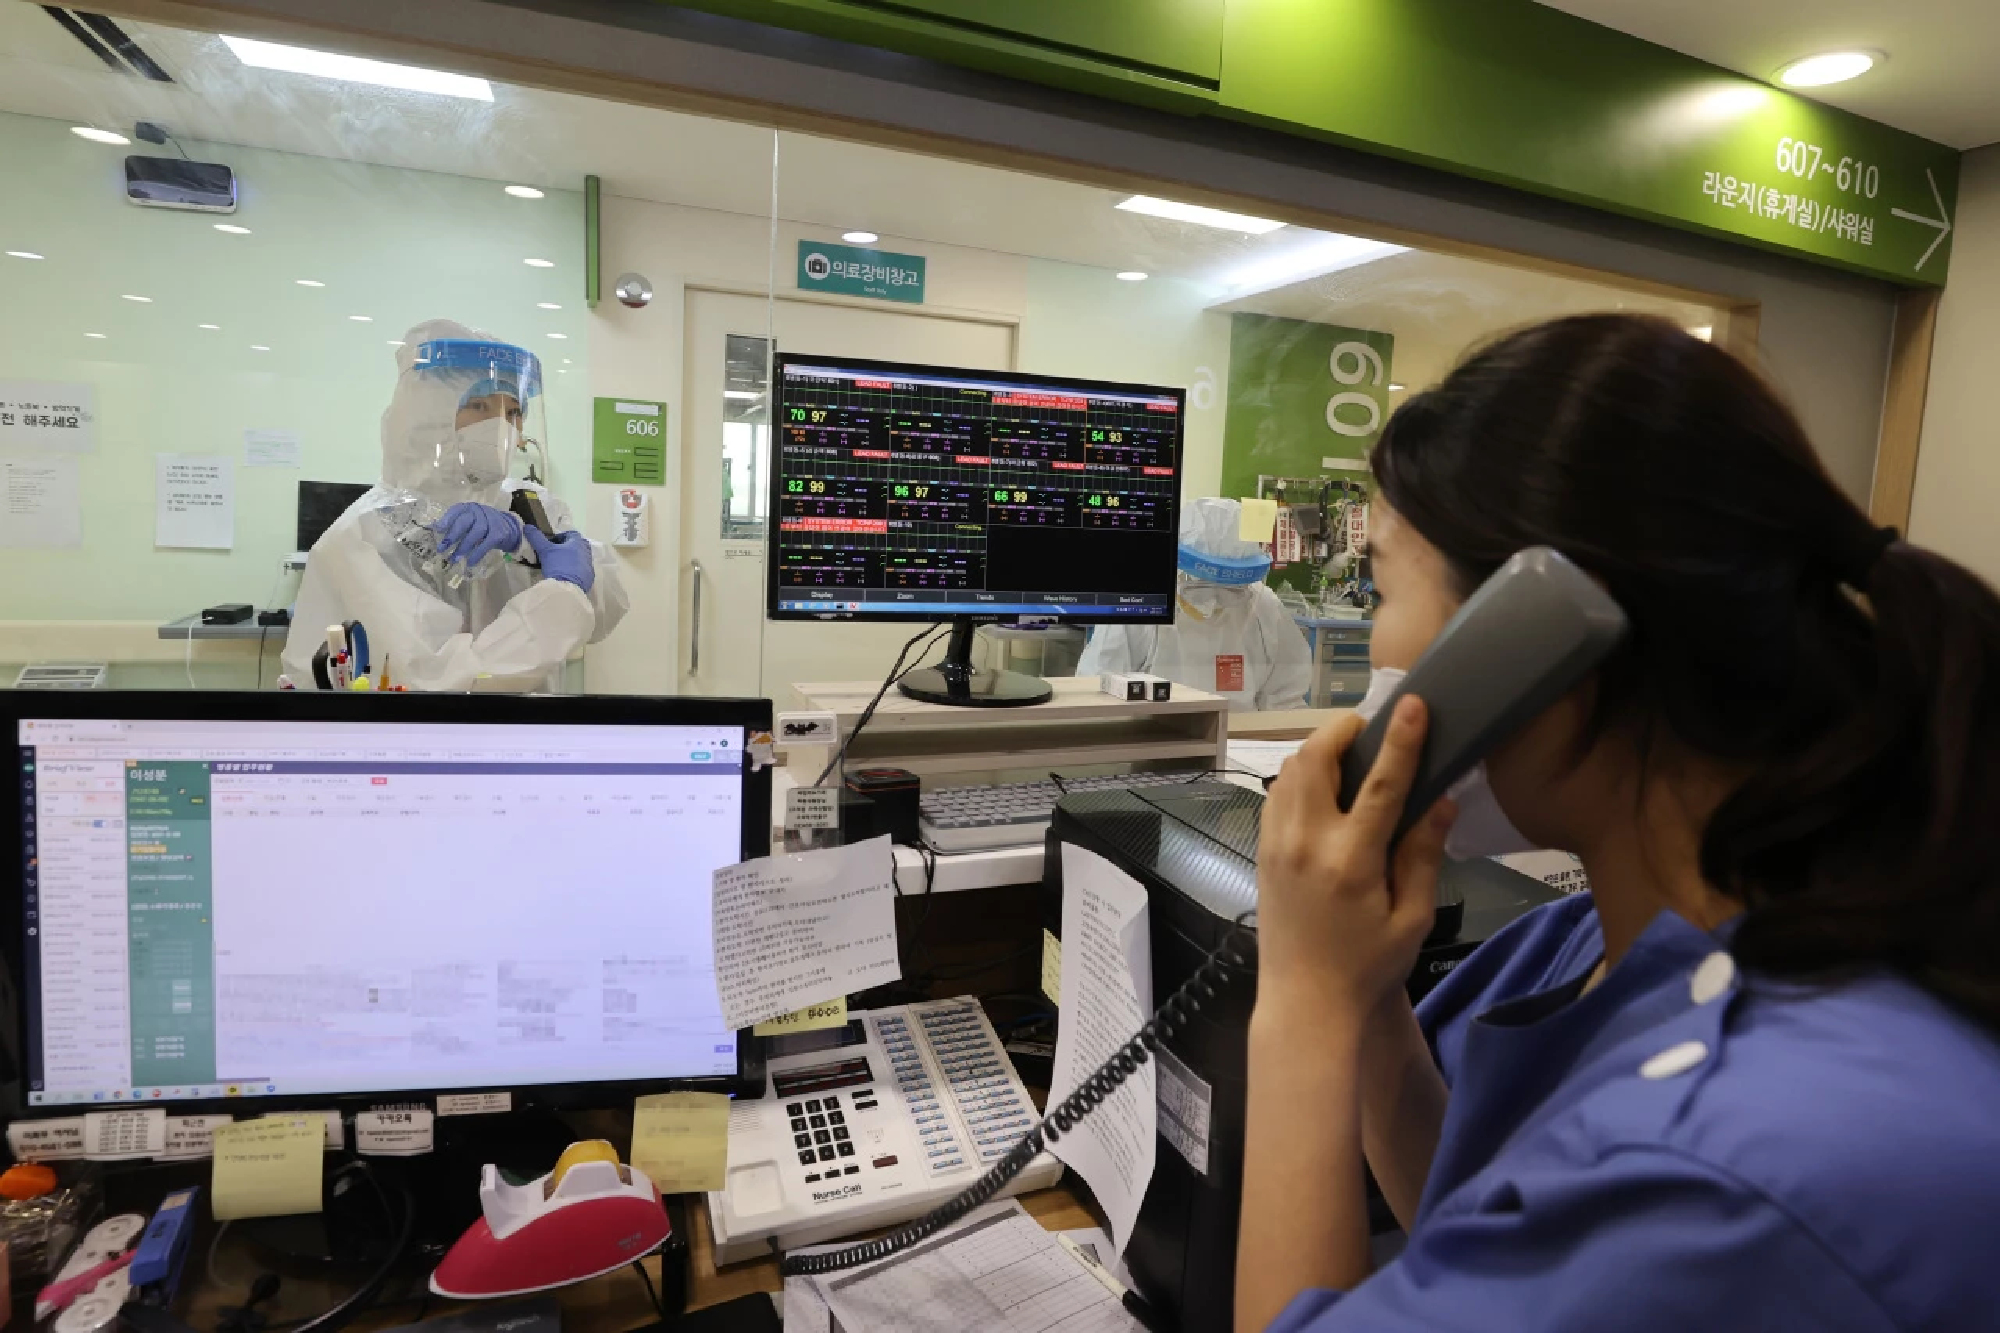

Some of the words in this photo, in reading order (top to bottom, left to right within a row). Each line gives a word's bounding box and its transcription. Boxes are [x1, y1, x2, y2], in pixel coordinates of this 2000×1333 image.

[1775, 136, 1879, 199] 607~610
[1702, 170, 1875, 246] 라운지(휴게실)/샤워실
[831, 260, 920, 287] 의료장비창고
[23, 413, 80, 429] 해주세요
[790, 408, 806, 421] 70
[811, 410, 828, 423] 97
[626, 419, 660, 437] 606
[788, 480, 804, 492] 82
[809, 480, 825, 493] 99
[894, 485, 909, 497] 96
[915, 487, 929, 498] 97
[812, 1188, 842, 1200] Nurse
[843, 1182, 862, 1195] Call
